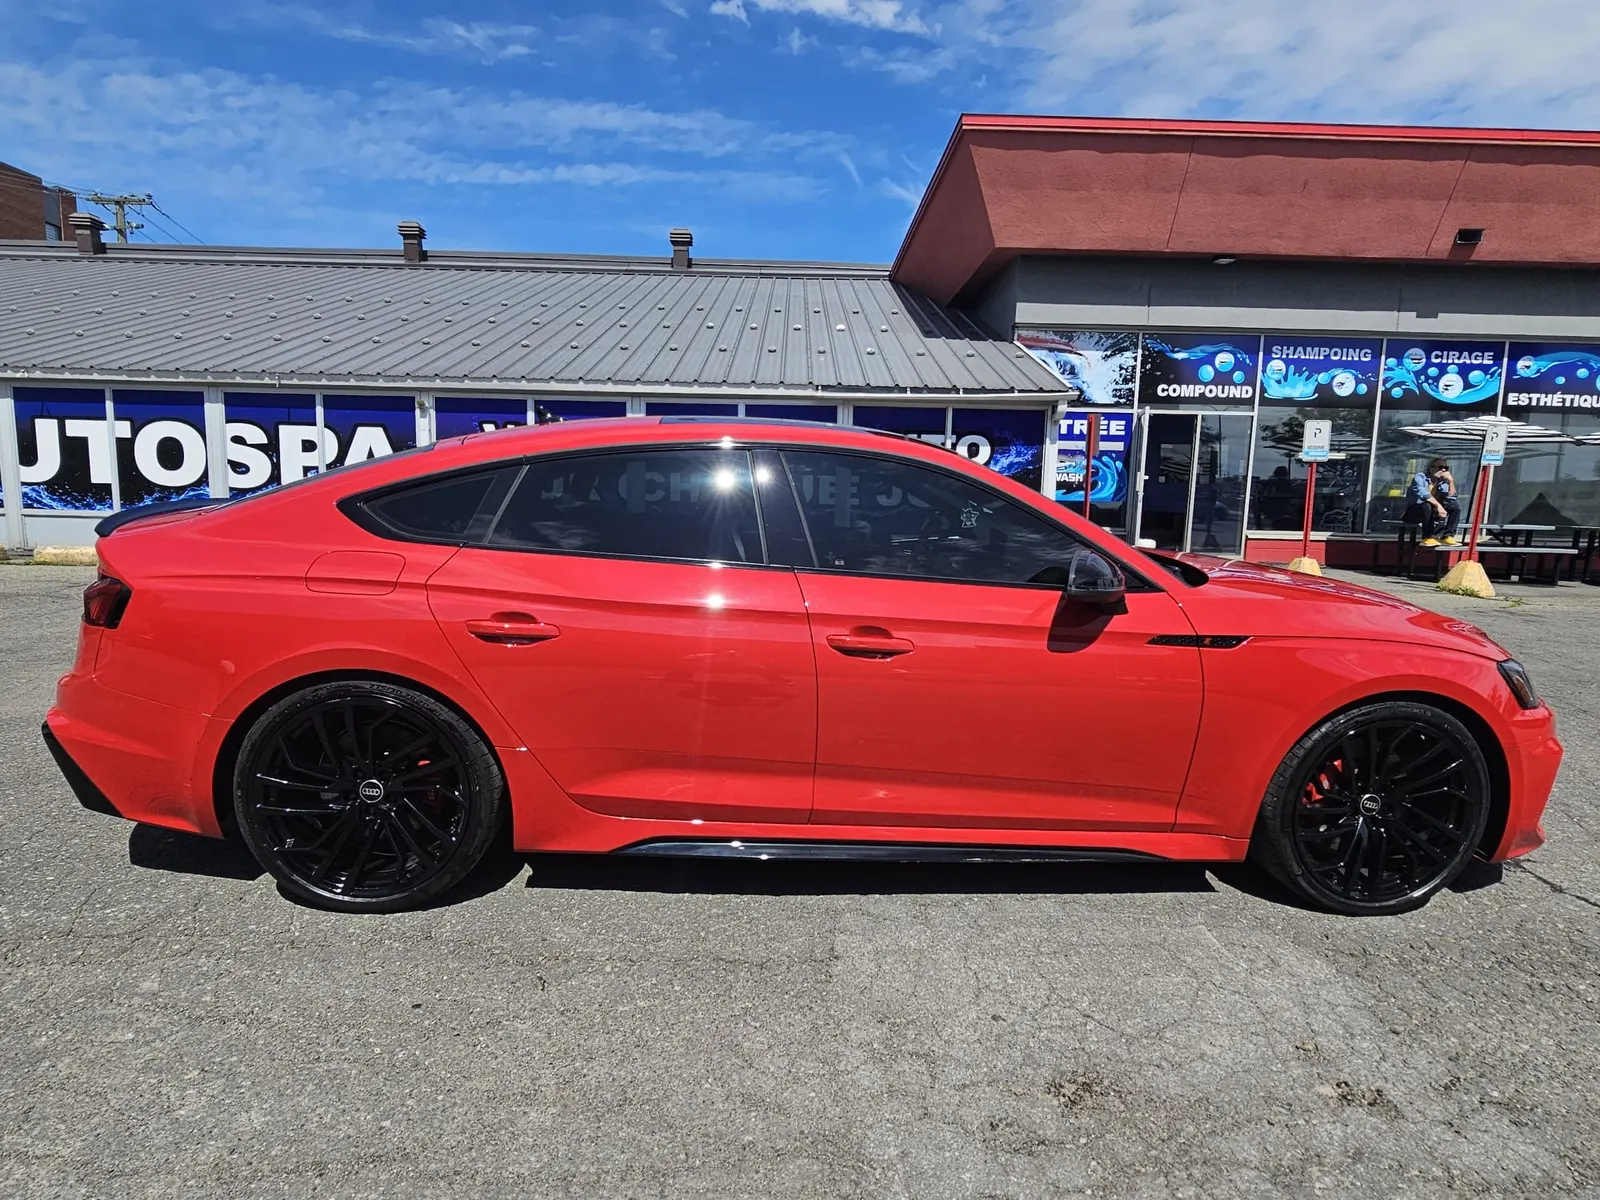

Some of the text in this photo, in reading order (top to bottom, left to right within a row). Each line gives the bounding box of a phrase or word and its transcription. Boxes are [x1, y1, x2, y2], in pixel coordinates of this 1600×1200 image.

[1271, 345, 1372, 362] SHAMPOING
[1430, 350, 1494, 365] CIRAGE
[1156, 384, 1253, 399] COMPOUND
